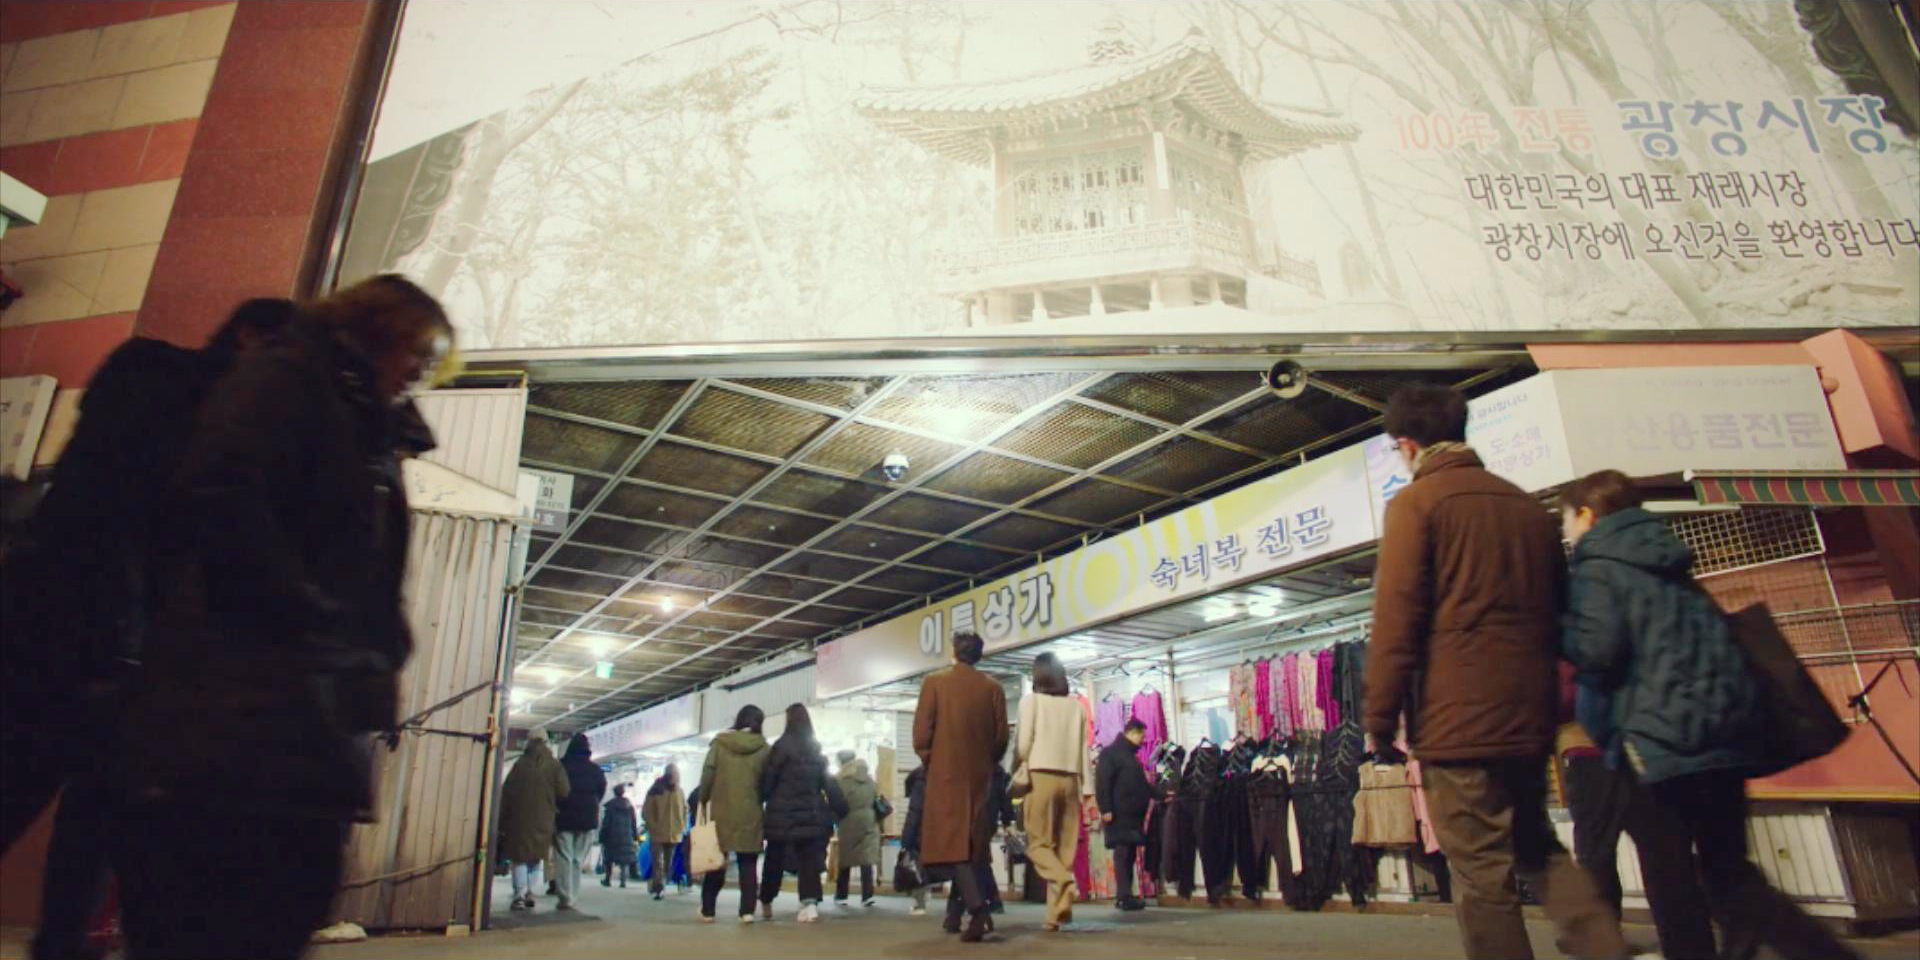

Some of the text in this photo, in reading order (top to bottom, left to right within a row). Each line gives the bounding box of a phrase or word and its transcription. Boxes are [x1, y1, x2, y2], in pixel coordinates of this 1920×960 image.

[1512, 107, 1594, 151] 전통
[1617, 97, 1882, 157] 광창시장
[1465, 170, 1807, 210] 대한민국의 대표 재래시장
[1483, 217, 1920, 261] 광창시장에 오신것을 환영합니다
[1150, 505, 1332, 590] 숙녀복 전문
